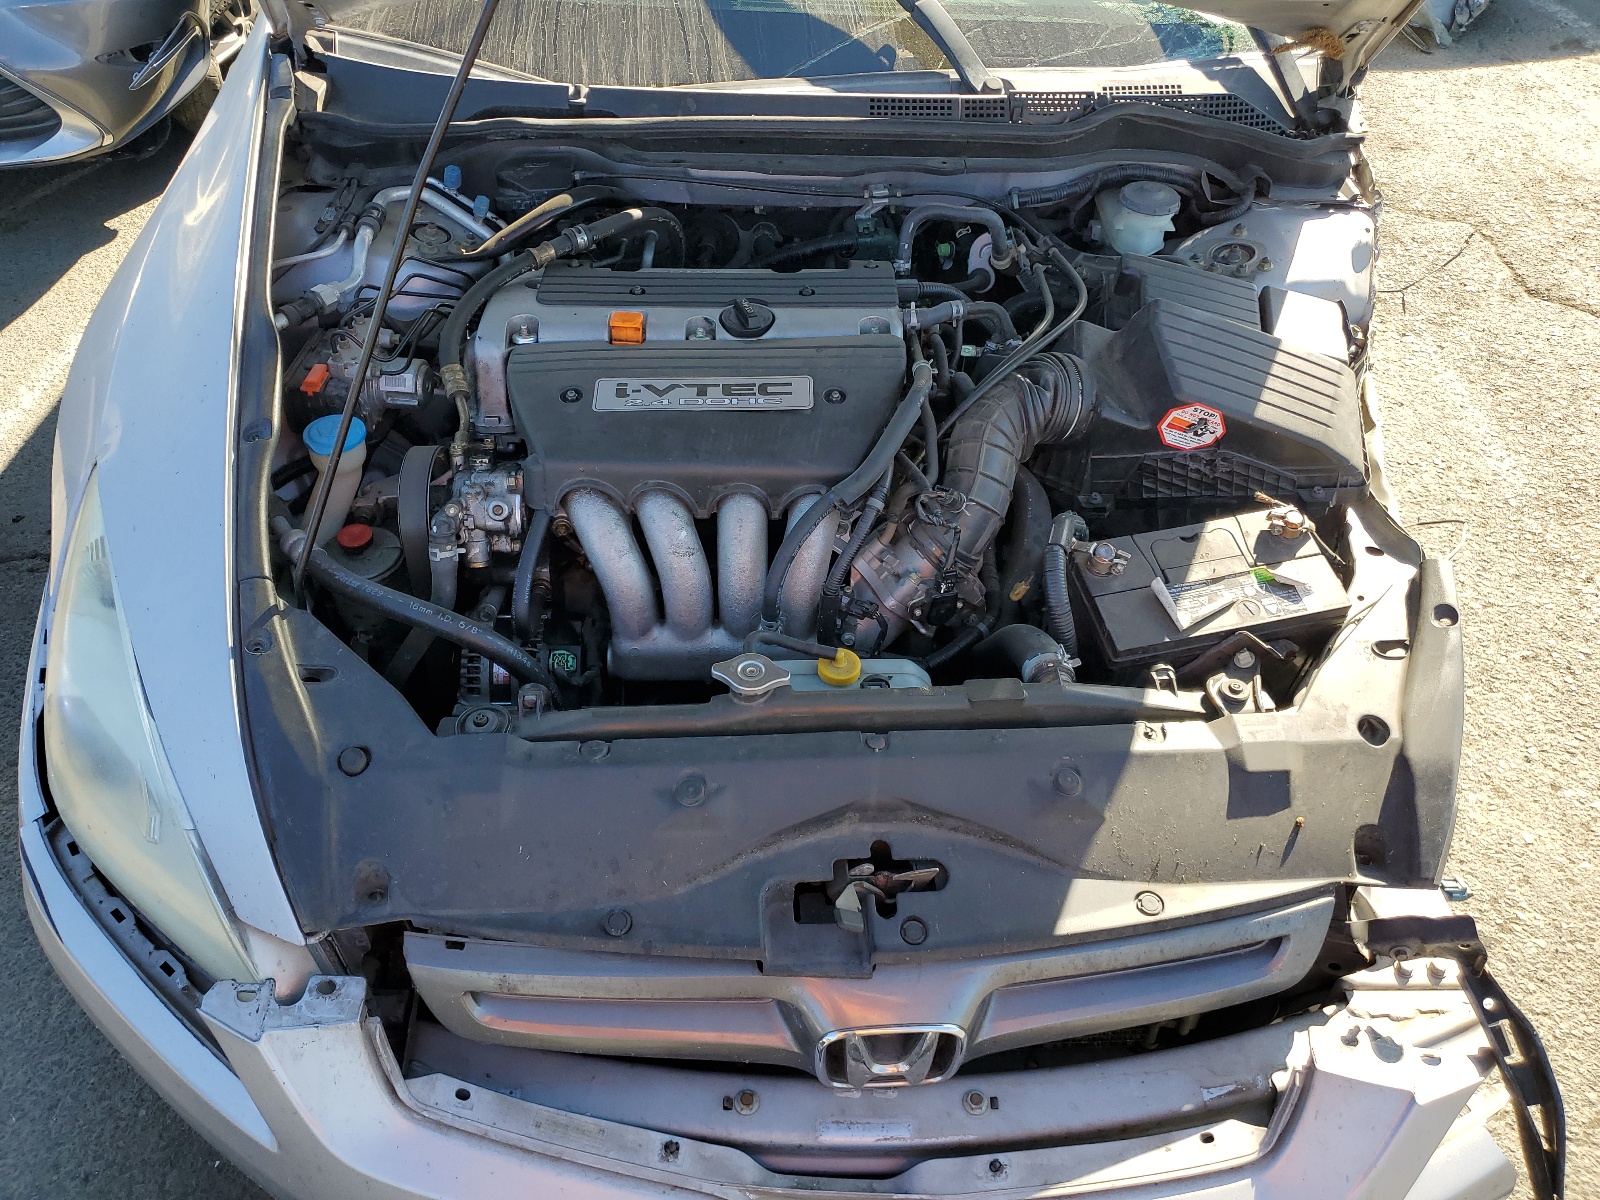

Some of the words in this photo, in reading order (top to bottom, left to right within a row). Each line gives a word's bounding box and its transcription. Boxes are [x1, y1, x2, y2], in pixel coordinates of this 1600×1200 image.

[615, 382, 793, 398] i-VTEC
[624, 398, 672, 406] 2.4
[679, 397, 783, 406] DOHC
[1192, 407, 1218, 419] STOP!
